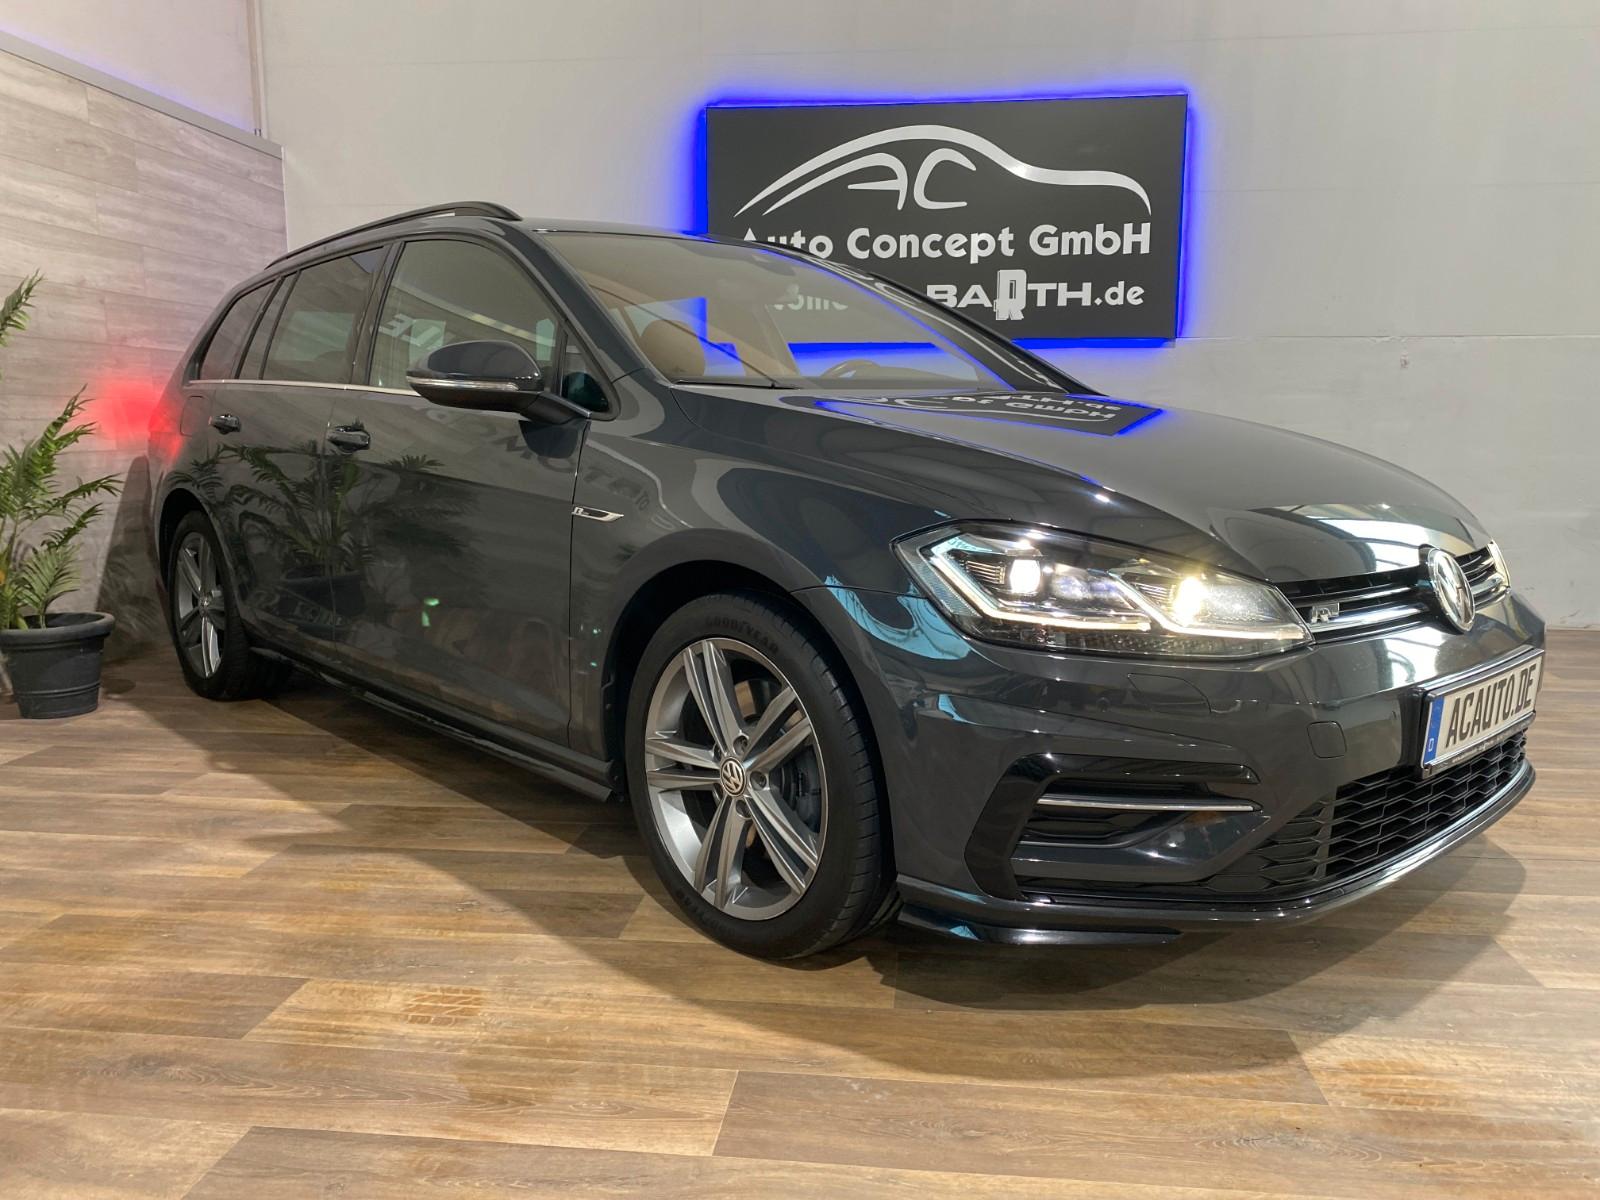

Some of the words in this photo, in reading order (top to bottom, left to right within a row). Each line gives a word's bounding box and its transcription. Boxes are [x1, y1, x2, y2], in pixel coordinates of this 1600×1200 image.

[847, 226, 1015, 265] Concept
[1029, 222, 1151, 257] GmbH
[1445, 663, 1537, 749] ACAUTO.DE
